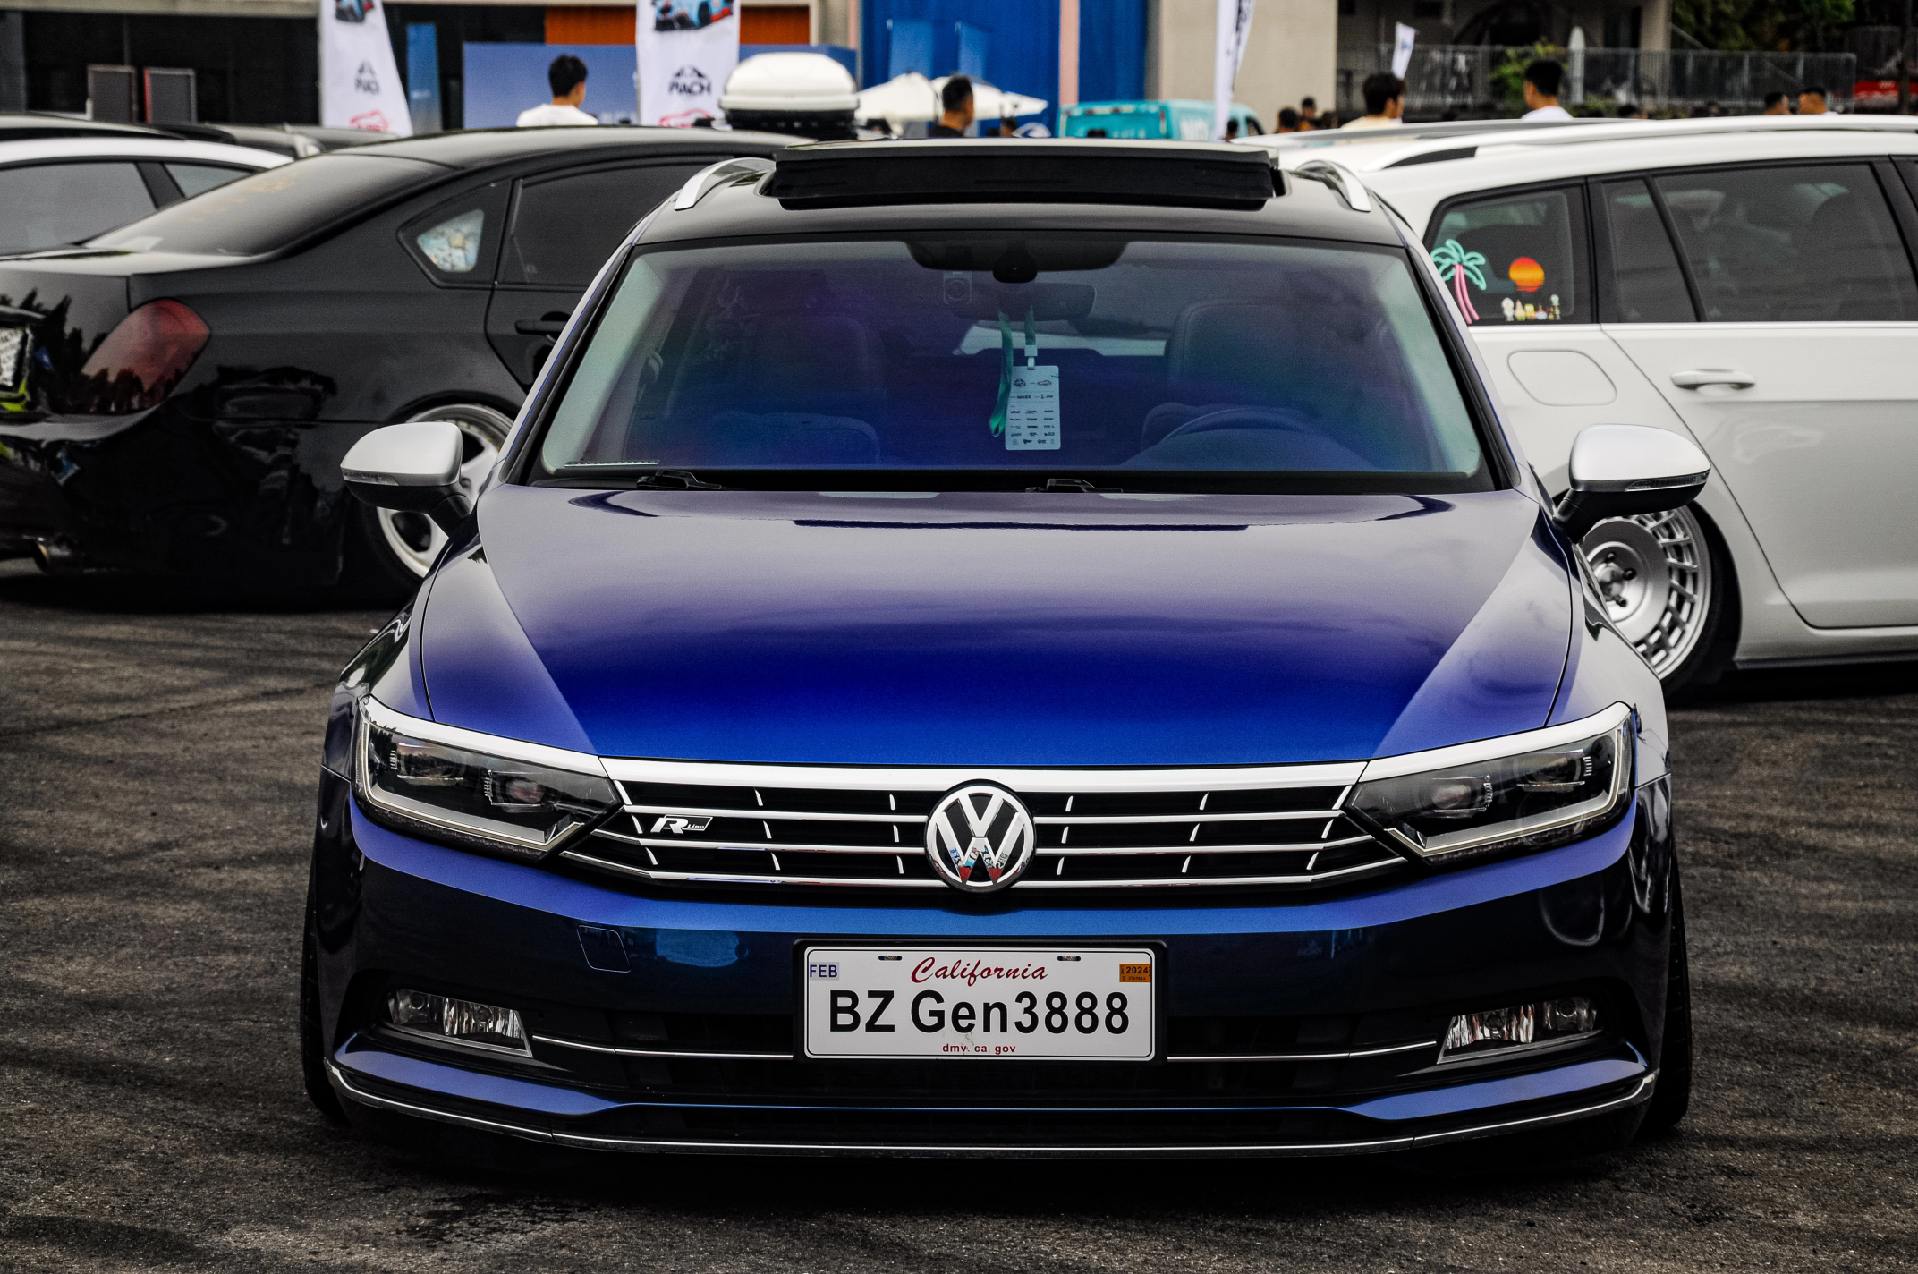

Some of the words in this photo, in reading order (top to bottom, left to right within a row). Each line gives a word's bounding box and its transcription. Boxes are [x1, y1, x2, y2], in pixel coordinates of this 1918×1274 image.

[649, 817, 689, 834] R
[810, 964, 837, 978] FEB
[911, 956, 1049, 987] California
[1125, 965, 1149, 974] 2024
[829, 989, 896, 1033] BZ
[911, 989, 1130, 1034] Gen3888
